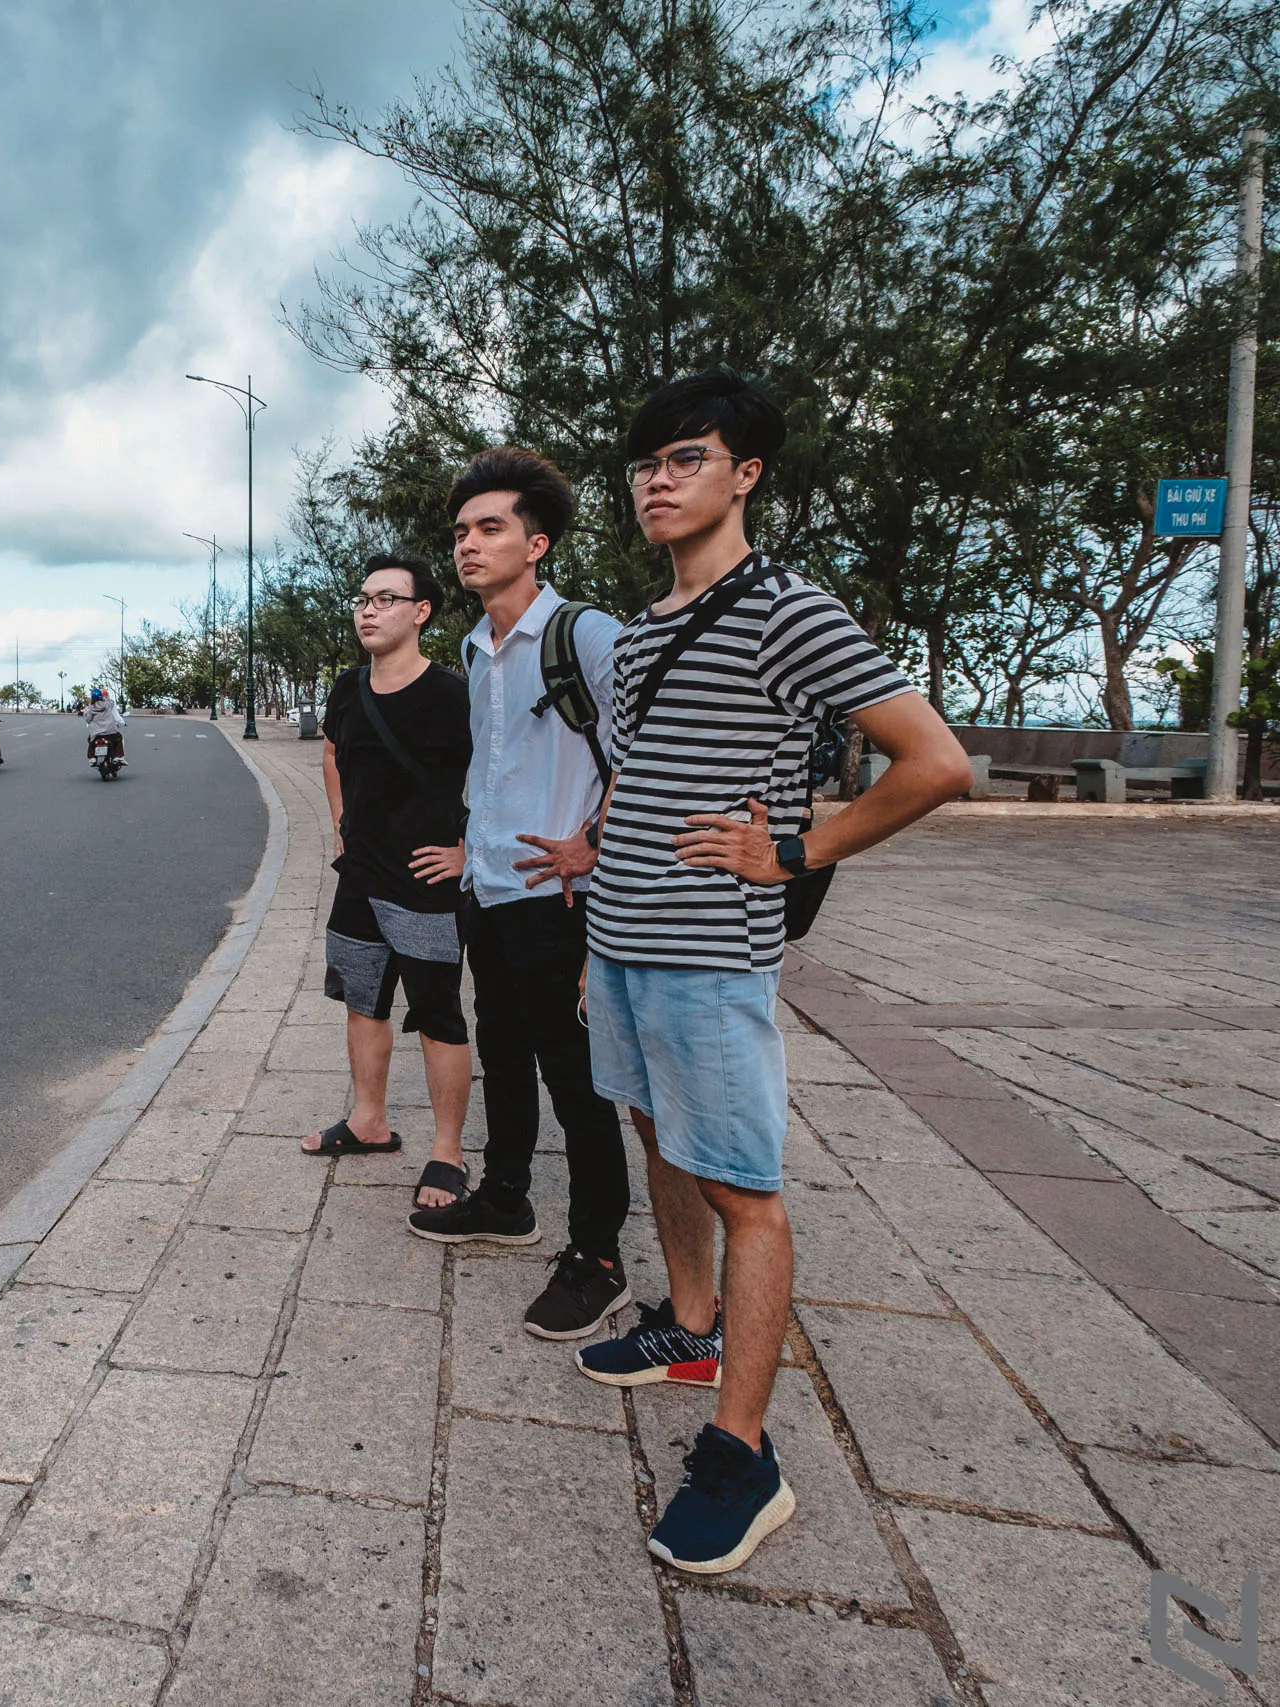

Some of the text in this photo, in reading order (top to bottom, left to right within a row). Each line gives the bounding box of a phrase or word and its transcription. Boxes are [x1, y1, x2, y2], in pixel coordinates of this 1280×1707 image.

[1203, 488, 1217, 503] XE
[1171, 508, 1208, 527] THU PHÍ
